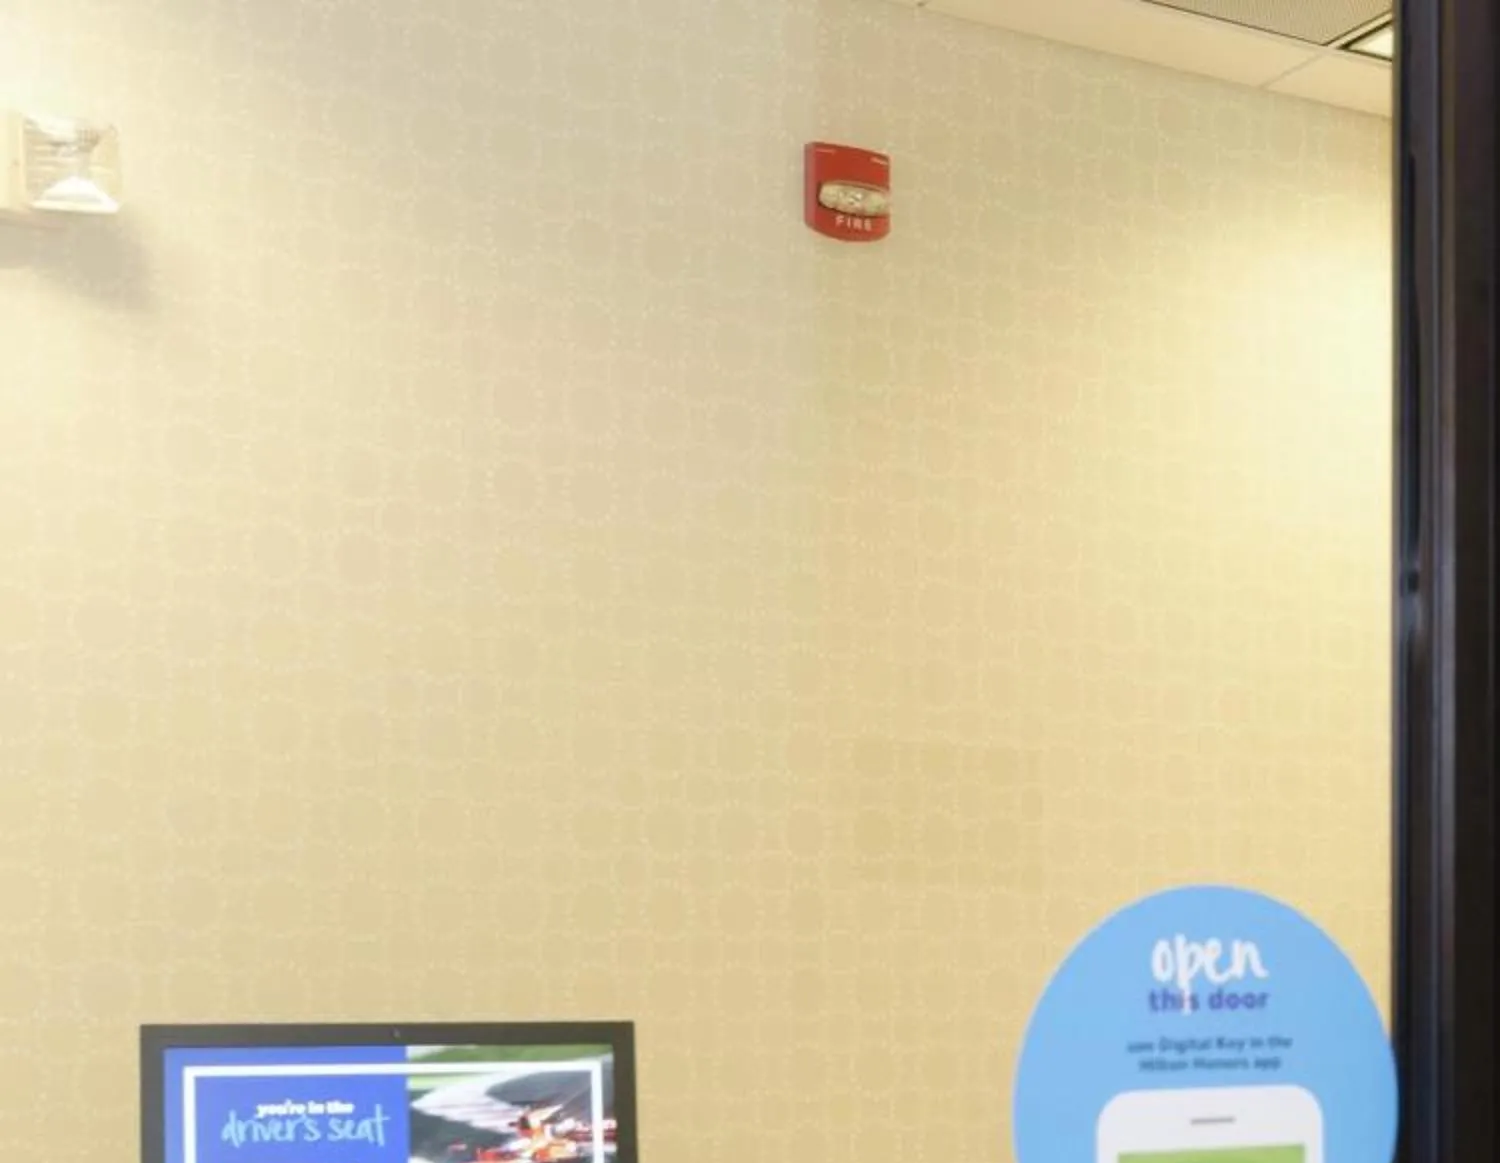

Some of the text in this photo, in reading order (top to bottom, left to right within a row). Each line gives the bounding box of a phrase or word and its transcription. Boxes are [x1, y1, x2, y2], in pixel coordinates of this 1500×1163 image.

[1152, 934, 1269, 1016] open
[1207, 986, 1270, 1011] door
[307, 1100, 325, 1115] in
[326, 1100, 355, 1115] the
[221, 1103, 391, 1148] driver's seat
